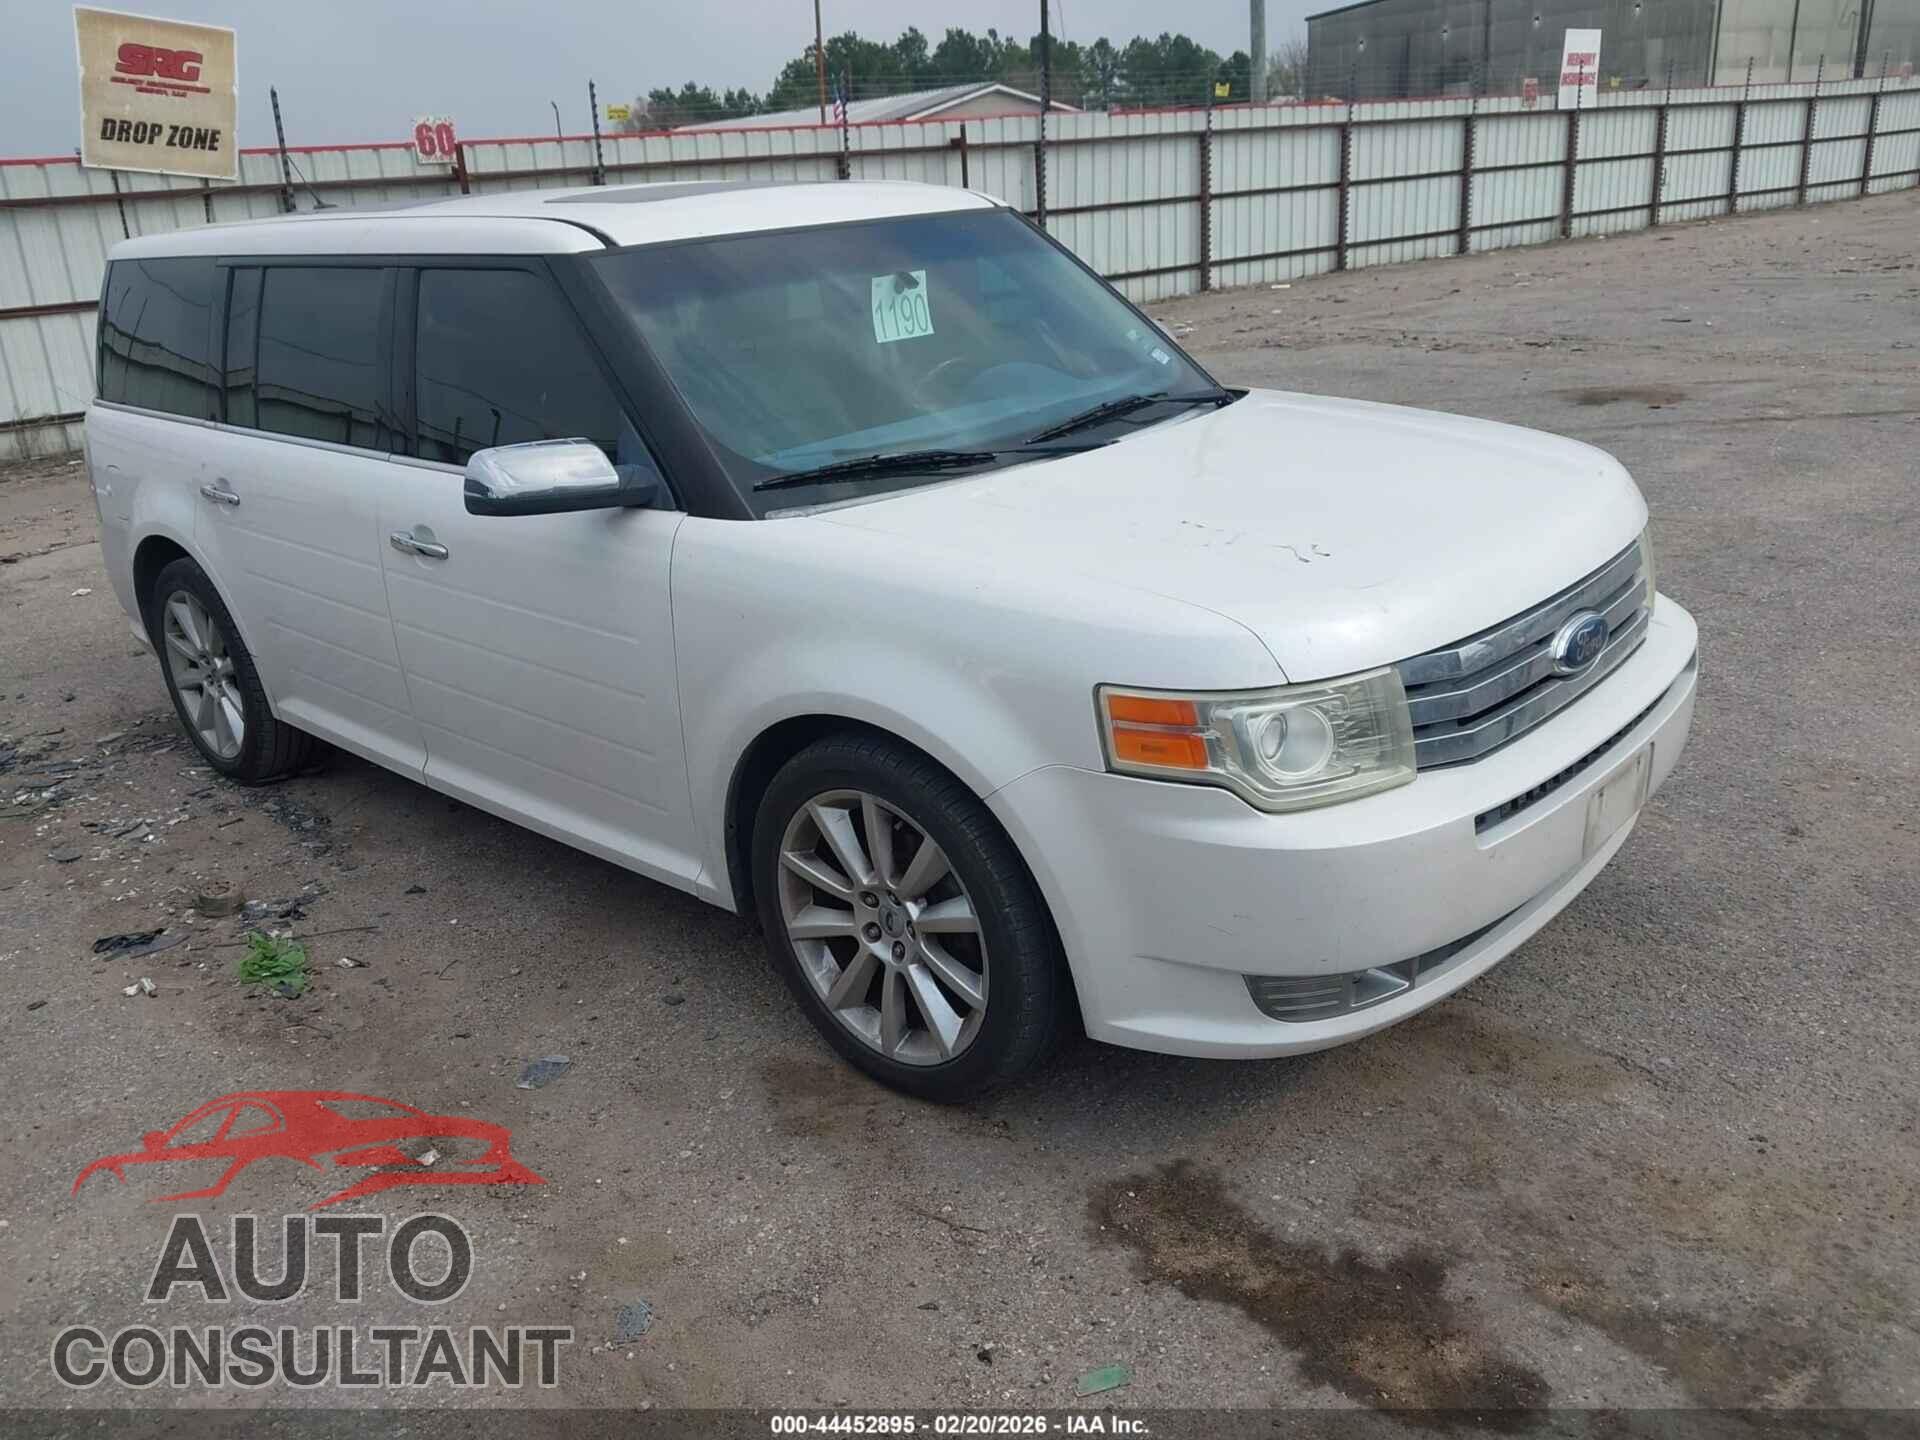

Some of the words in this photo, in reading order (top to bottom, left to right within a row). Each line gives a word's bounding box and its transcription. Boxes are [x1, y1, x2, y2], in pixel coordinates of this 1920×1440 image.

[115, 43, 203, 82] SRG
[101, 118, 163, 145] DROP
[166, 125, 221, 151] ZONE
[415, 122, 456, 156] 60
[875, 293, 928, 339] 1190
